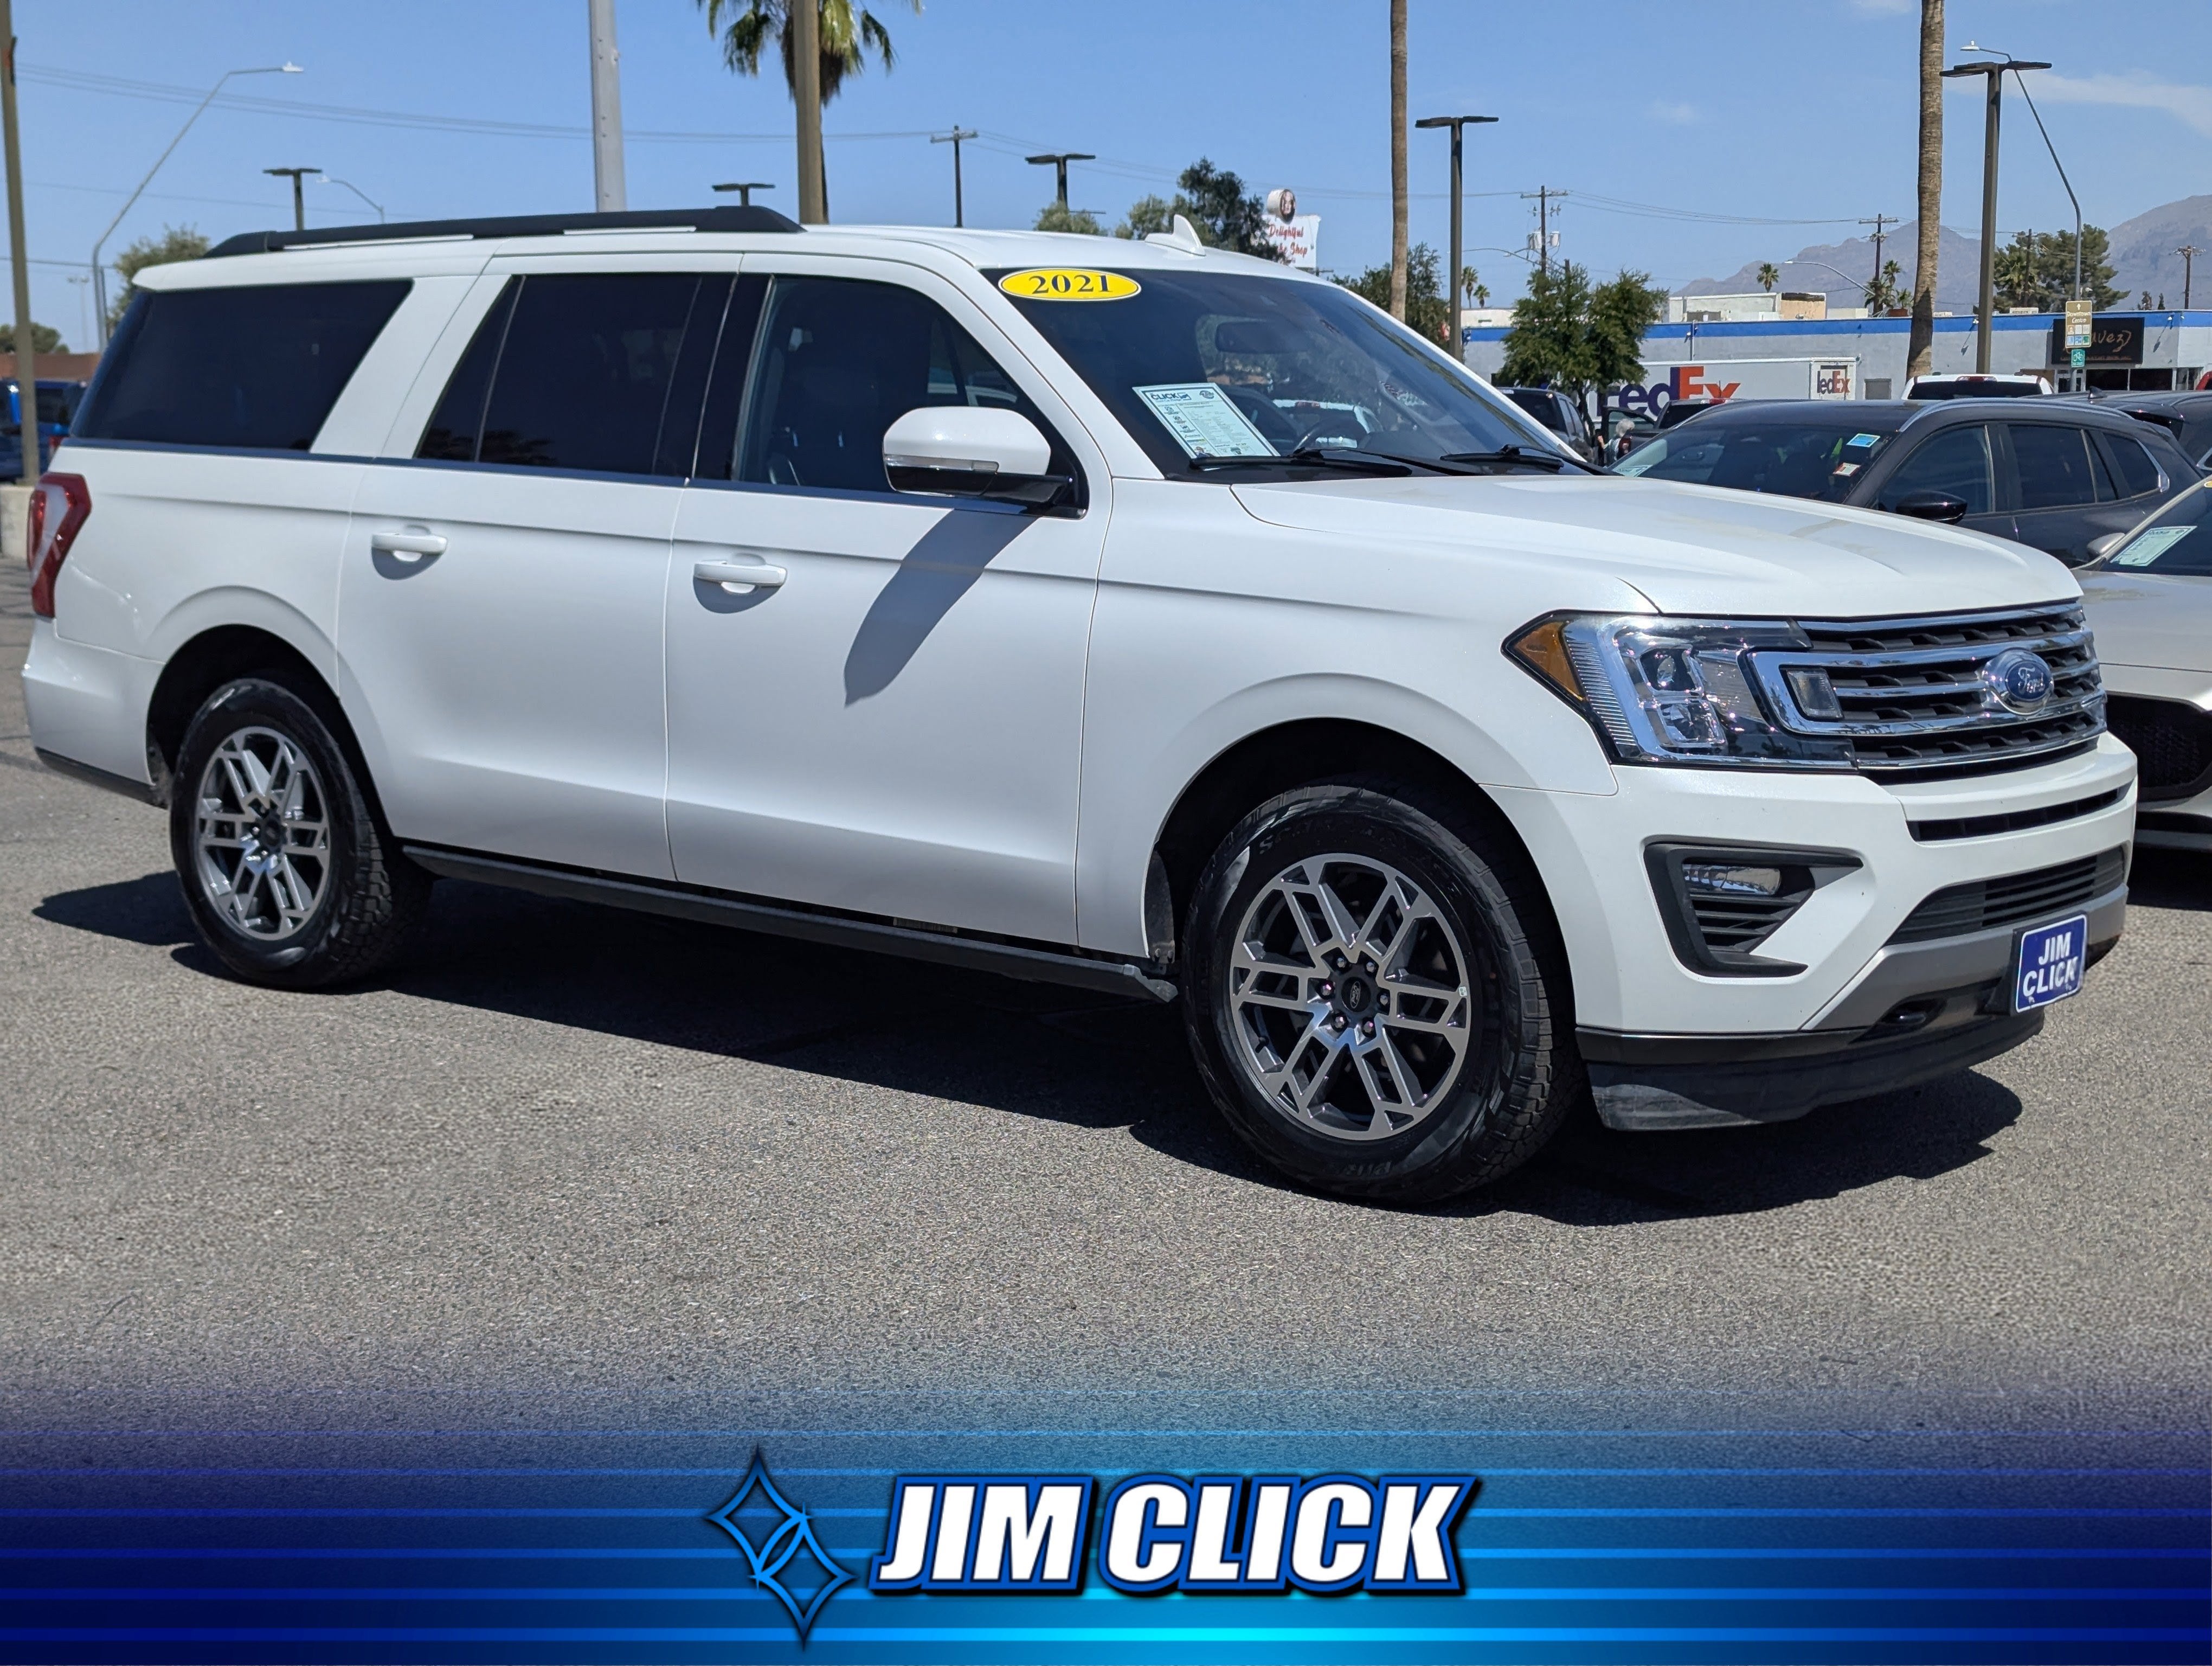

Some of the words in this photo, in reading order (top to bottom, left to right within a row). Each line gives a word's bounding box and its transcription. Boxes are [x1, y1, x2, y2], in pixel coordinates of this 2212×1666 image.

[1028, 274, 1114, 294] 2021
[2039, 932, 2072, 965] JIM
[2023, 956, 2079, 997] CLICK
